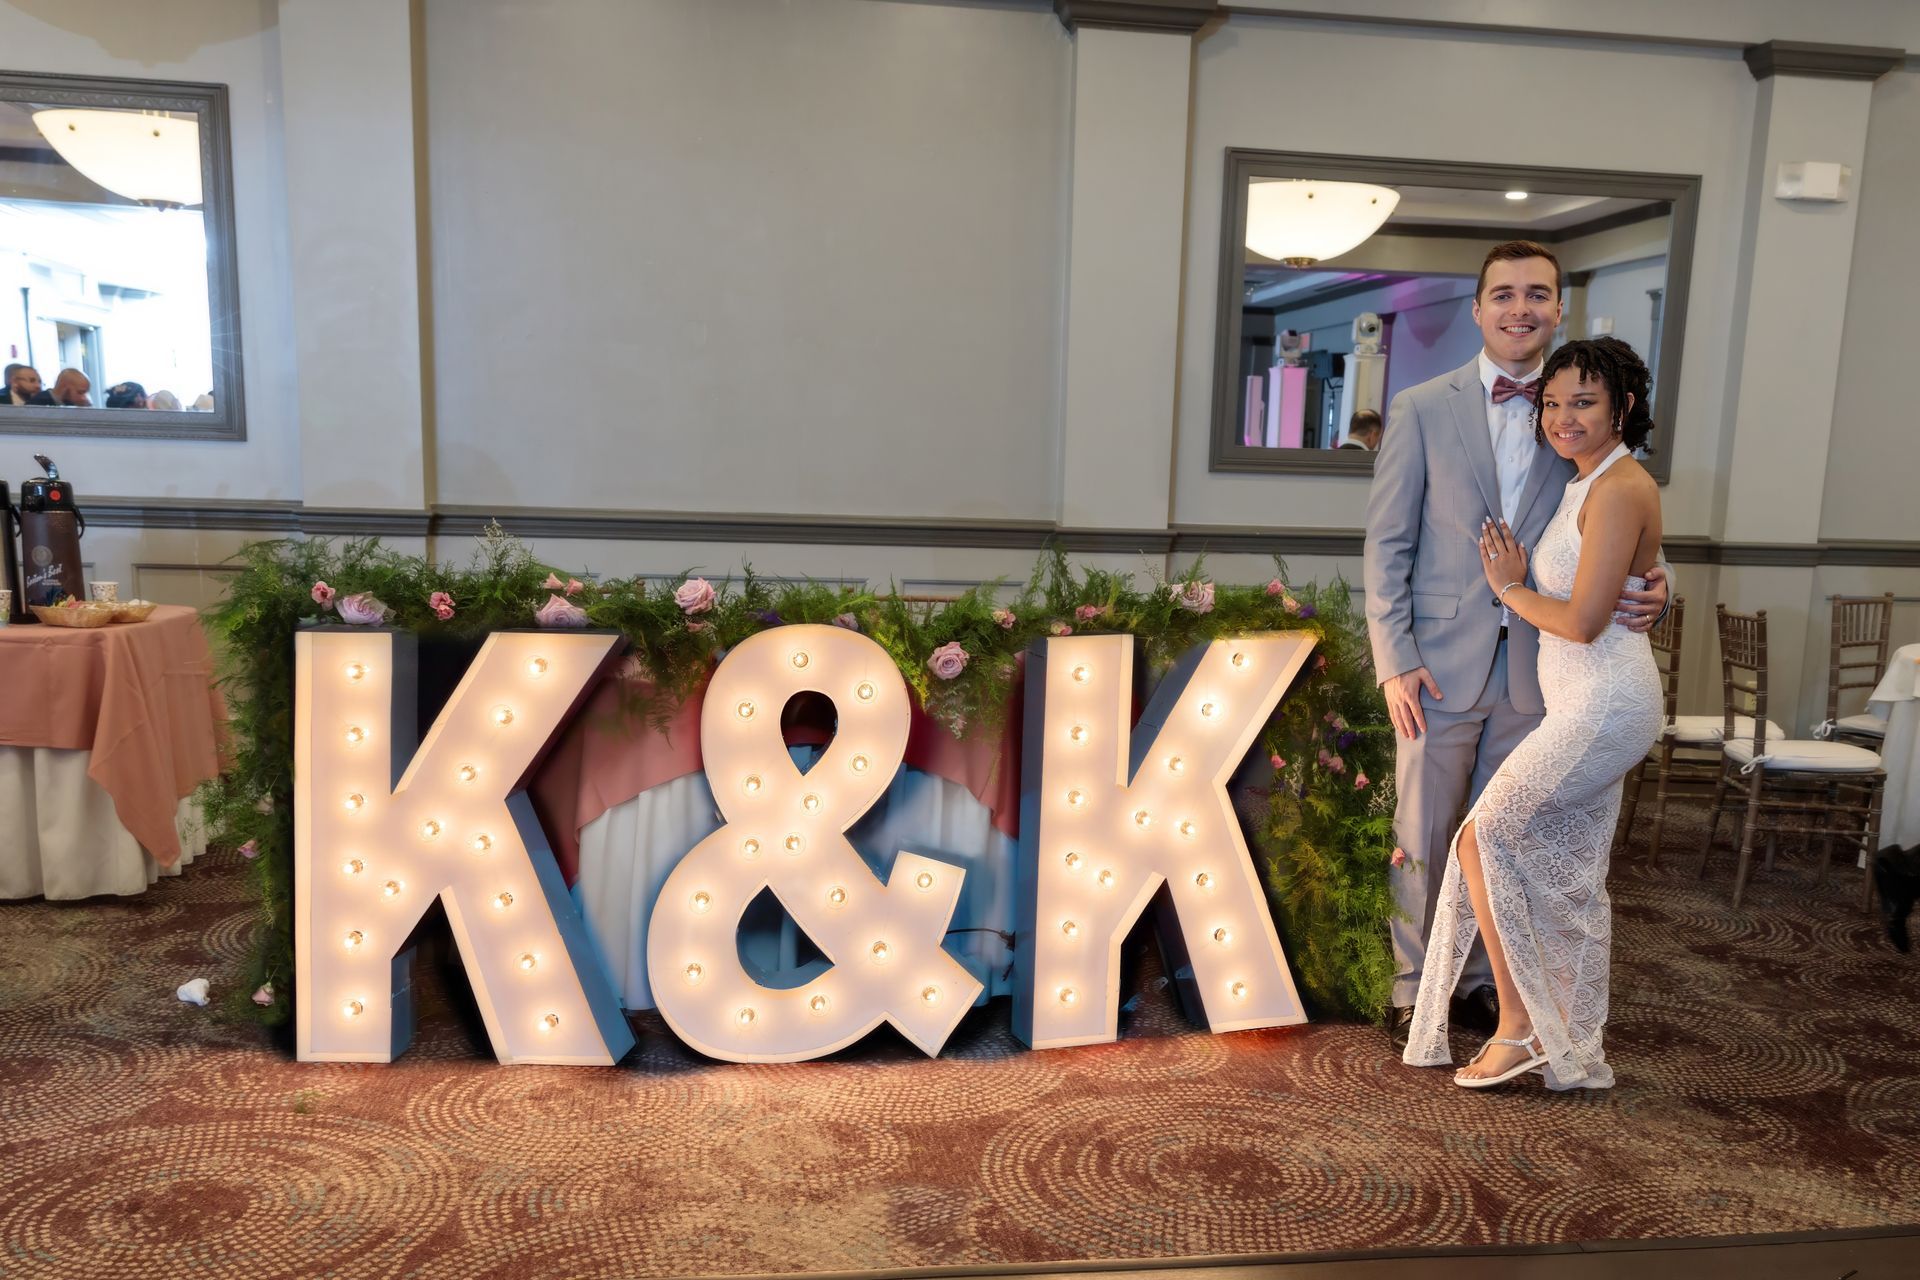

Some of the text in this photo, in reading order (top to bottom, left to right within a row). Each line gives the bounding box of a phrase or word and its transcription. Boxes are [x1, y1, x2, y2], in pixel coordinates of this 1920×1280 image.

[294, 623, 1321, 1067] K & K
